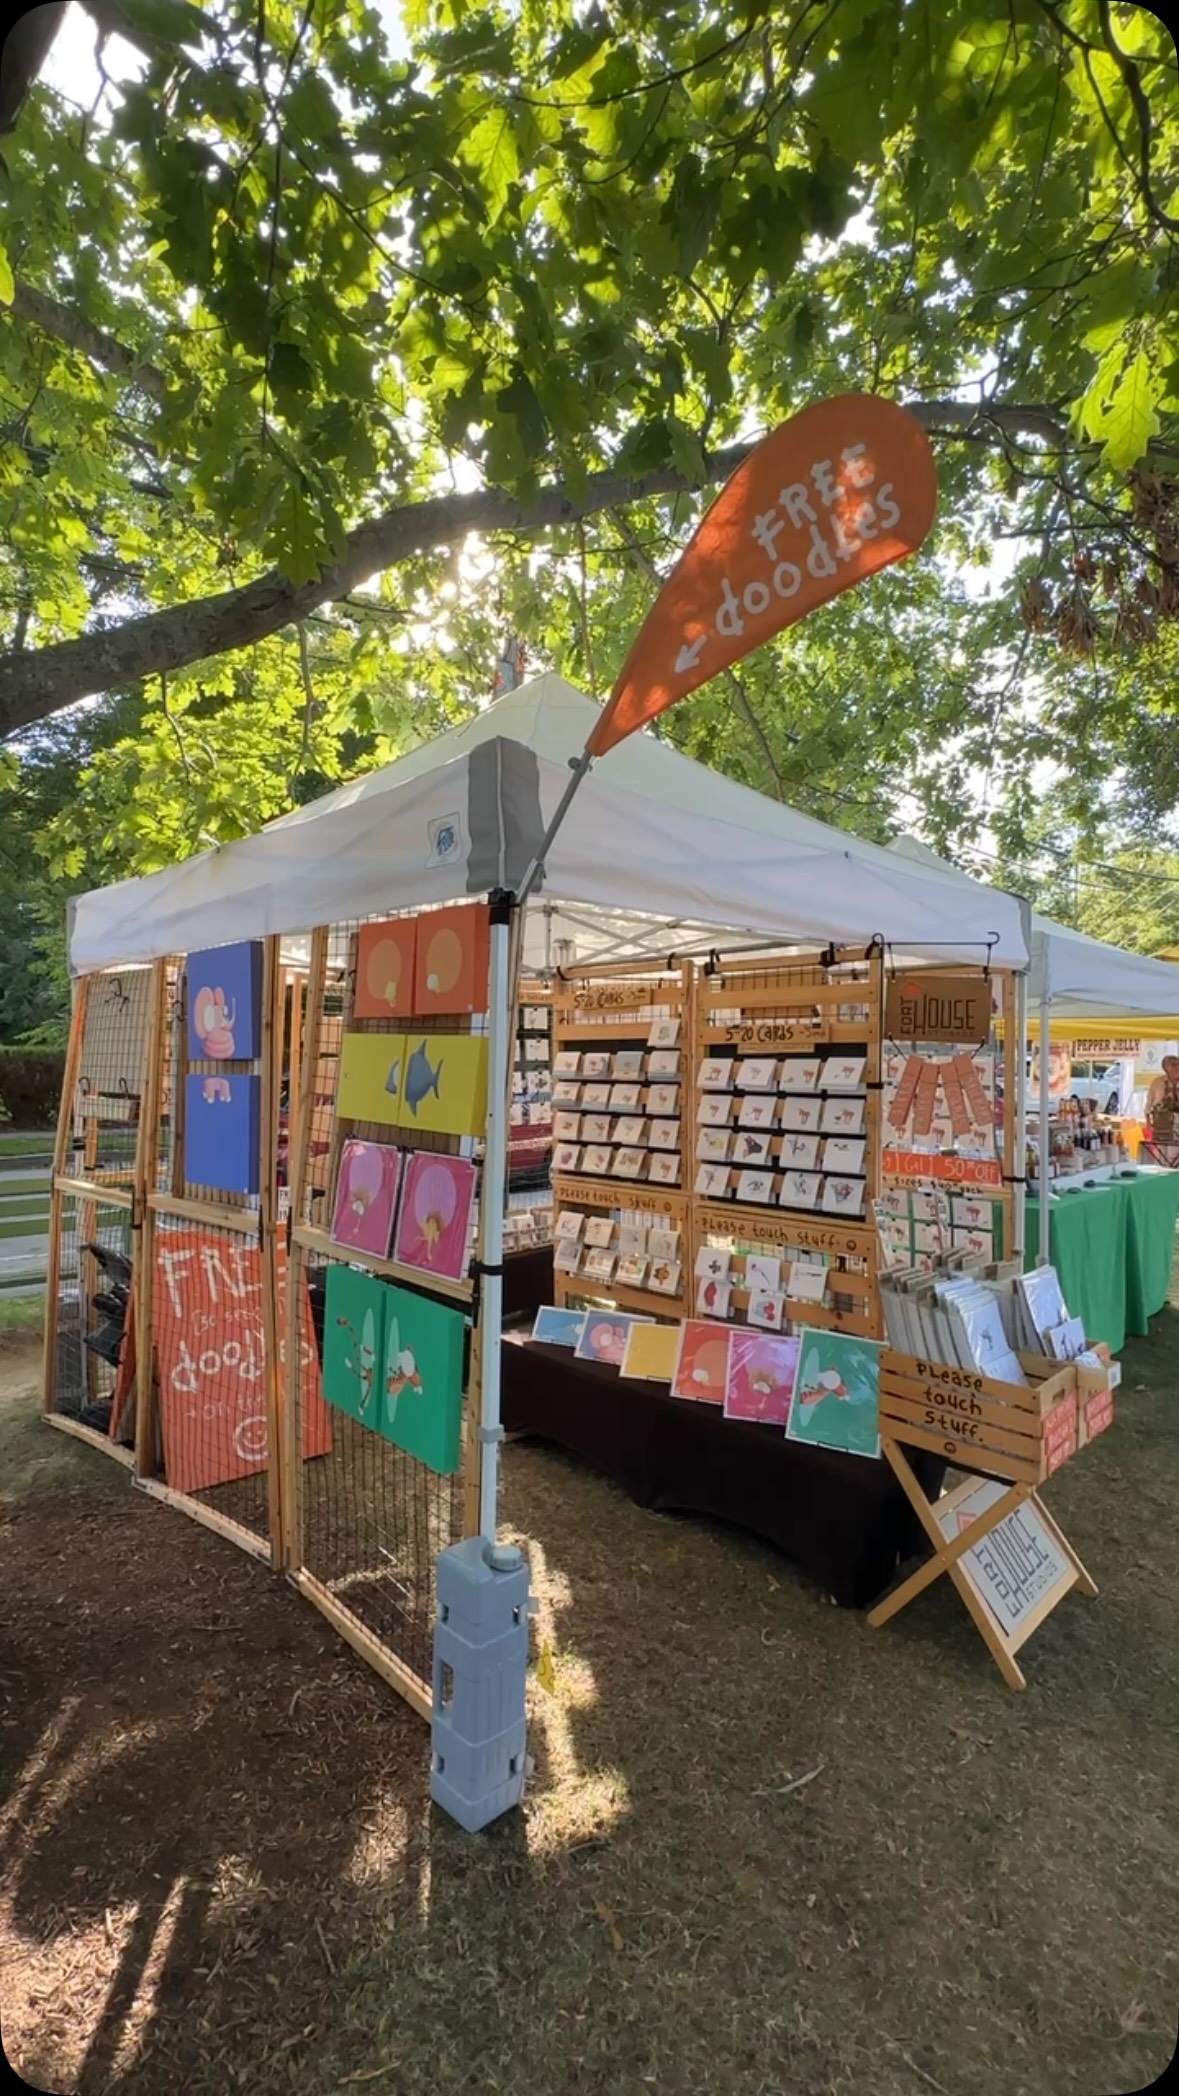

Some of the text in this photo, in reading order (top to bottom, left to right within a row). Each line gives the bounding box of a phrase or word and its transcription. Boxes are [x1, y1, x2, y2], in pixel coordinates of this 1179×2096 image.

[752, 443, 874, 560] FREE
[900, 995, 913, 1034] FORT
[913, 994, 977, 1035] HOUSE
[1077, 1039, 1111, 1052] PEPPER
[1113, 1039, 1140, 1052] JELLY
[593, 1192, 620, 1205] touch
[753, 1222, 789, 1242] touch
[924, 1387, 983, 1416] touch
[983, 1508, 1049, 1611] HOUSE
[970, 1547, 1021, 1618] FORT
[1025, 1560, 1059, 1600] STUDIOS
